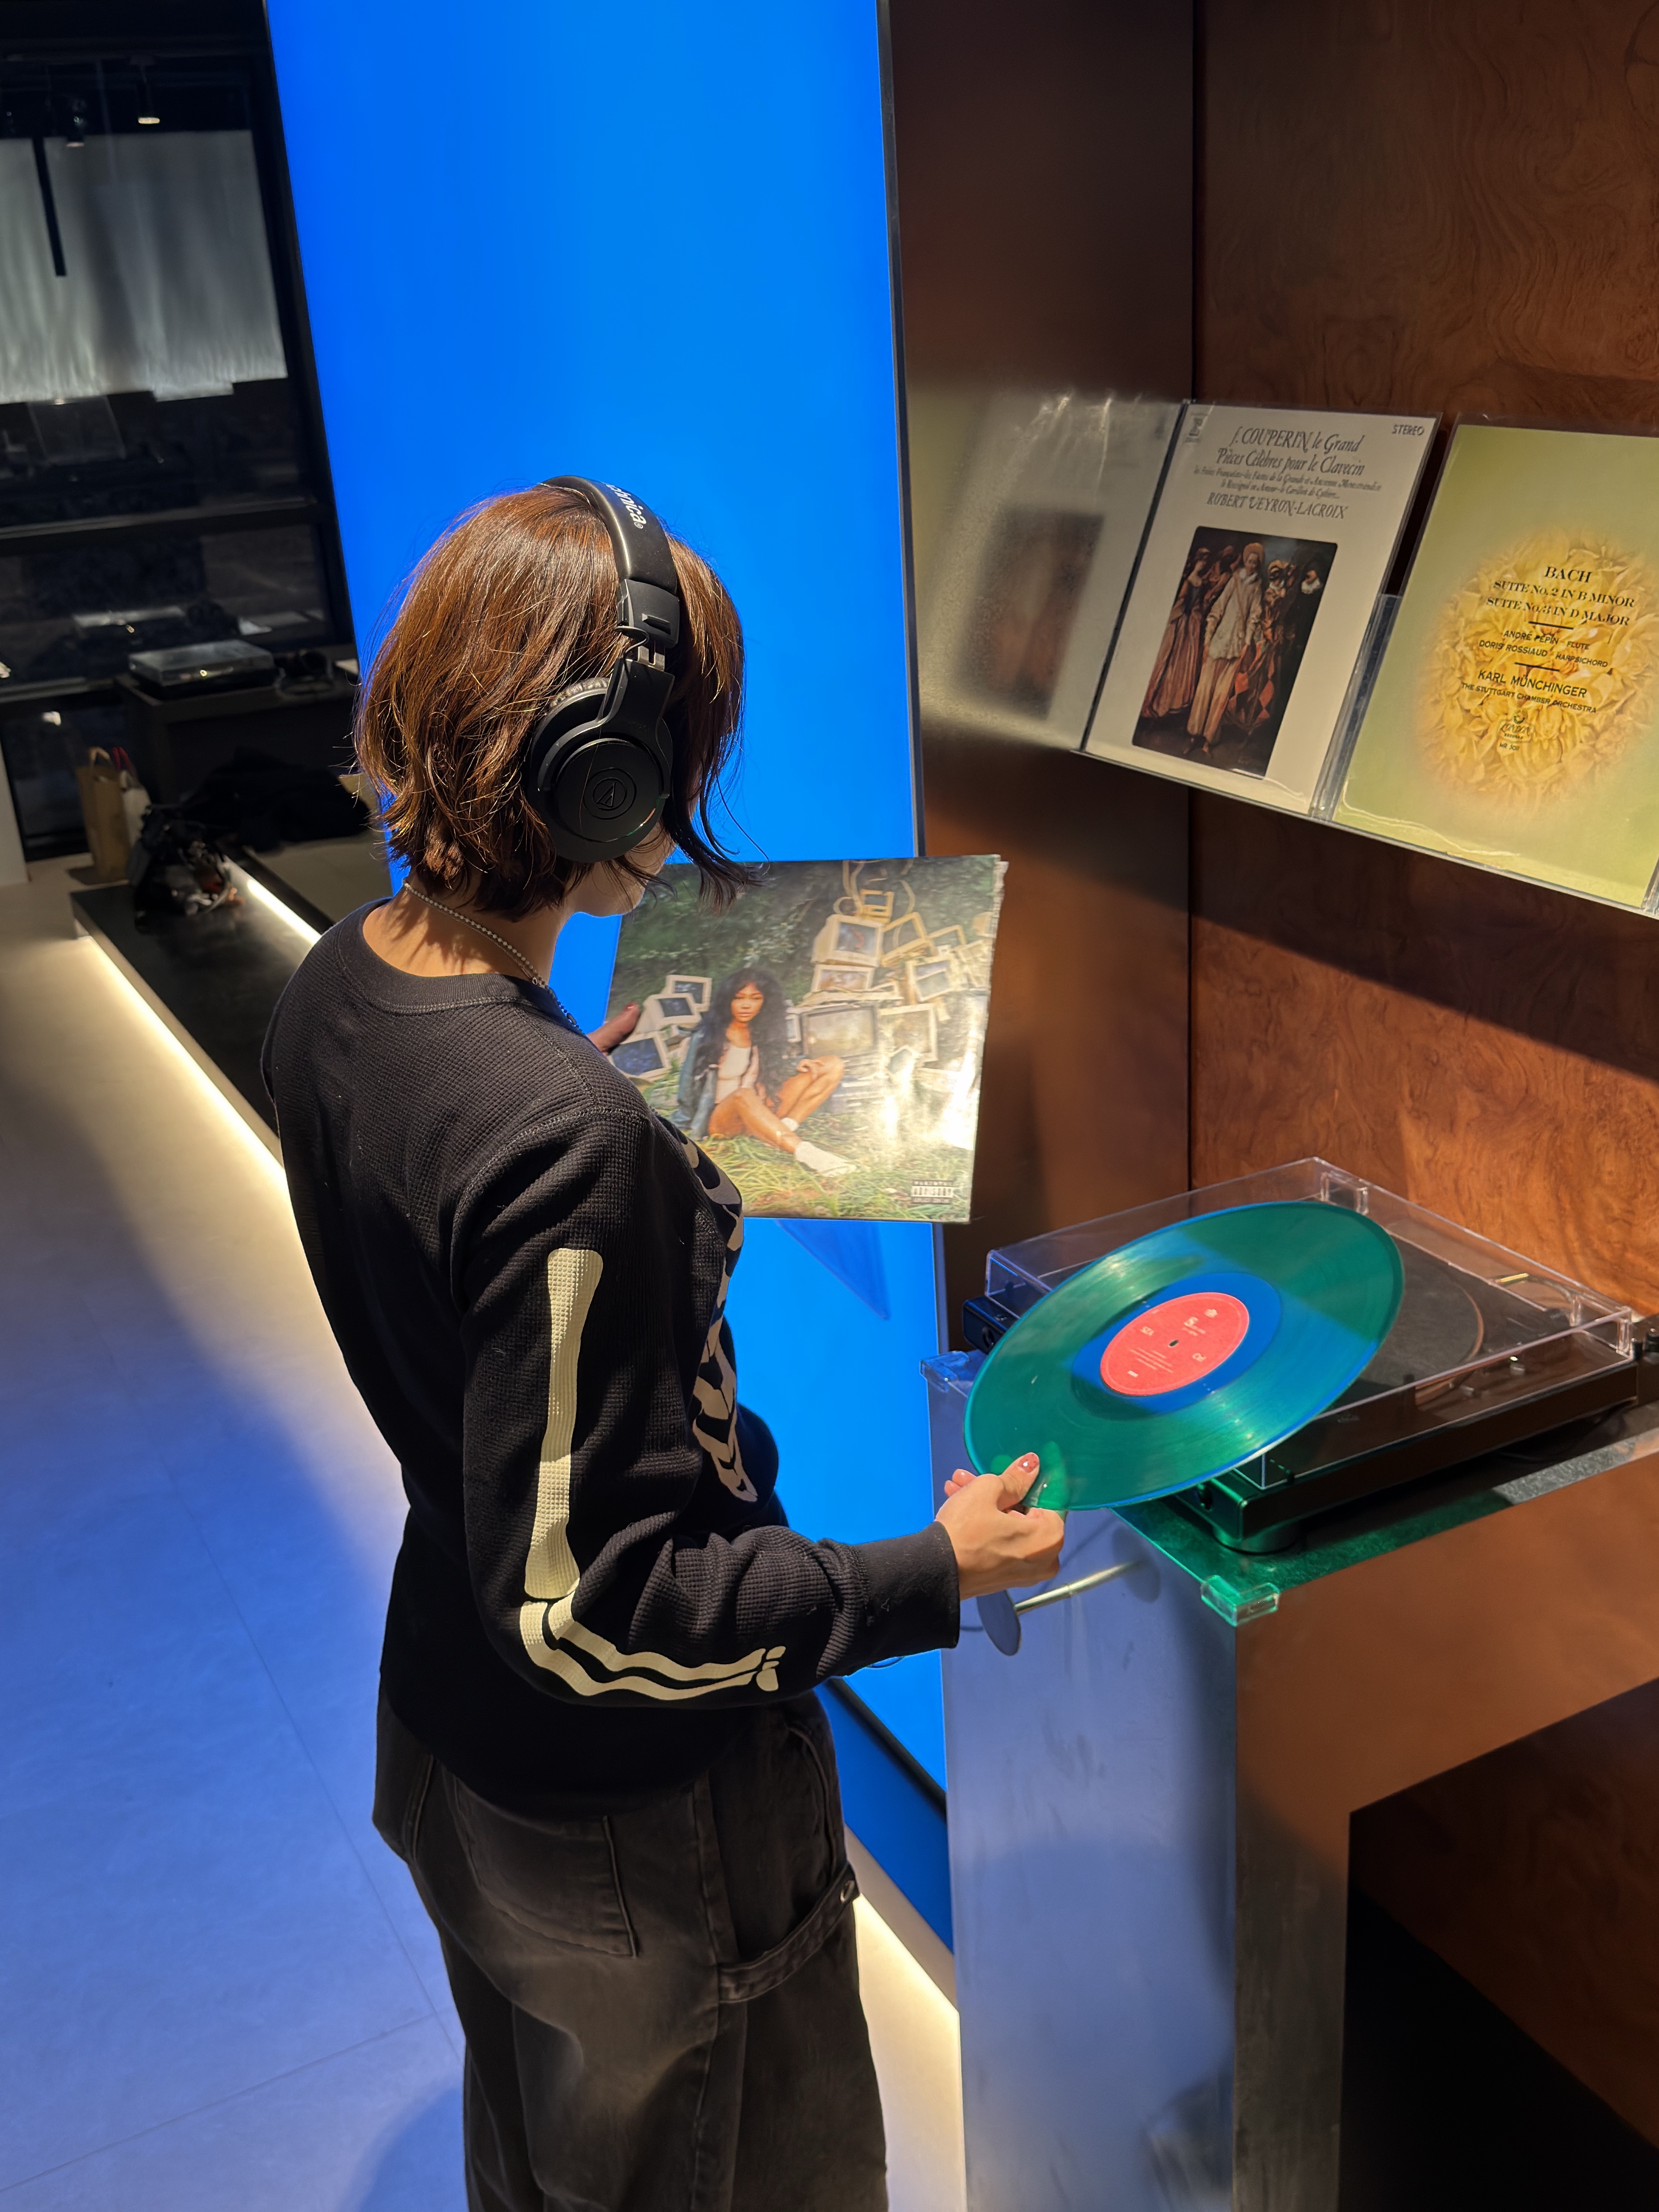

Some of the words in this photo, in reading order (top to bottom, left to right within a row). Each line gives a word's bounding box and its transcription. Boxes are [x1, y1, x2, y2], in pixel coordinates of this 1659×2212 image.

[1242, 428, 1313, 453] COUPERIN
[1312, 431, 1323, 449] le
[1324, 434, 1365, 454] Grand
[1392, 424, 1424, 436] STEREO
[1281, 457, 1307, 474] pour
[1307, 454, 1319, 471] le
[1320, 455, 1365, 476] Clavecin
[602, 483, 646, 524] chnica
[1207, 492, 1248, 508] ROBERT
[1544, 566, 1592, 583] BACH
[1493, 581, 1529, 592] SUITE
[1530, 585, 1548, 595] No.
[1551, 588, 1558, 596] 2
[1561, 589, 1576, 598] IN
[1577, 591, 1587, 600] B
[1589, 593, 1634, 607] MINOR
[1486, 598, 1522, 610] SUITE
[1523, 602, 1540, 613] No.
[1543, 605, 1551, 614] 3
[1553, 606, 1568, 616] IN
[1570, 609, 1579, 617] D
[1582, 611, 1630, 626] MAJOR
[1479, 640, 1505, 649] DORIS
[1506, 644, 1547, 657] ROSSIAUD
[1556, 652, 1608, 667] HARPSICHORD
[1566, 641, 1590, 650] FLUTE
[1478, 670, 1506, 684] KARL
[1511, 674, 1587, 698] MÜNCHINGER
[1476, 685, 1515, 697] STUTTGART
[1517, 693, 1551, 704] CHAMBER
[1552, 700, 1596, 713] ORCHESTRA
